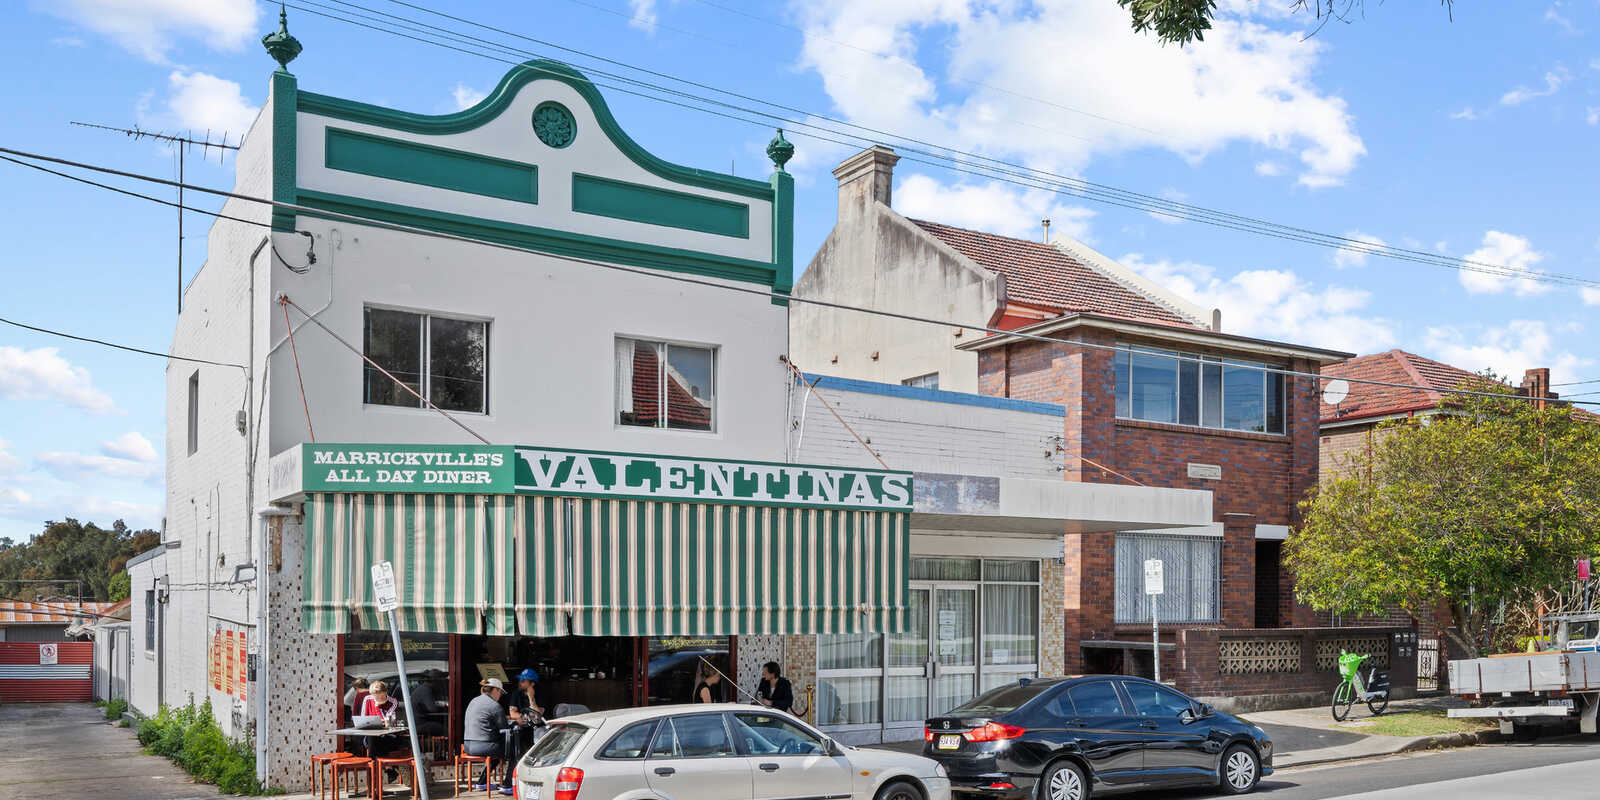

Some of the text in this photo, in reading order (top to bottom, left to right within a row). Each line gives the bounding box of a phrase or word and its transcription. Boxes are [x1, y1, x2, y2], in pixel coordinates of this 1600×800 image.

[313, 451, 504, 467] MARRICKVILLE'S
[325, 469, 492, 484] ALL DAY DINER
[519, 449, 911, 507] VALENTINAS
